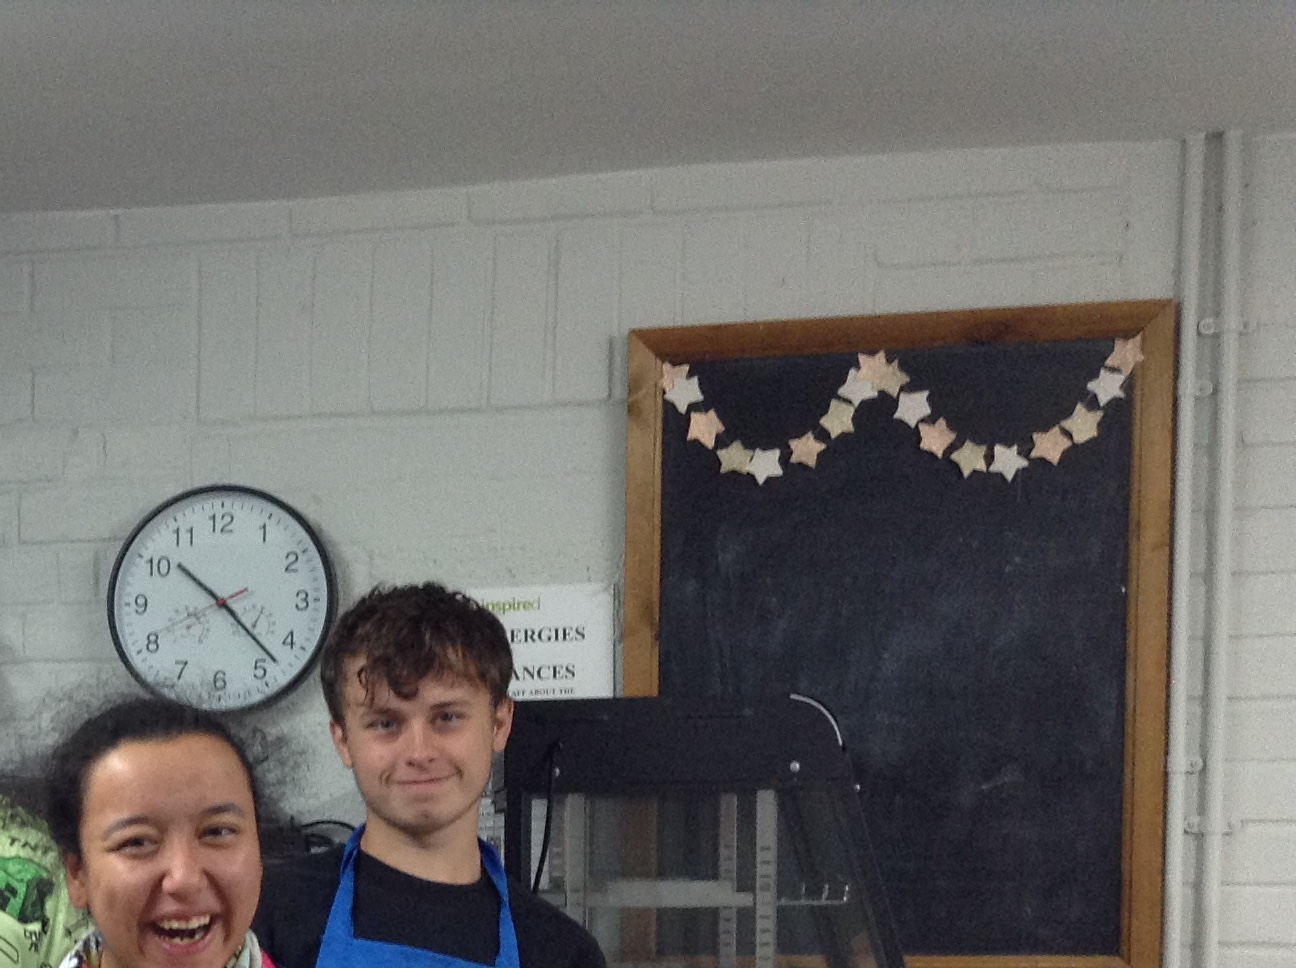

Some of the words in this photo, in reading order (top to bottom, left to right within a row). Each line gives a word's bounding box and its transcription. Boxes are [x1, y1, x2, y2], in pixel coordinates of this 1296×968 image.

[208, 512, 234, 534] 12
[259, 523, 266, 543] 1
[173, 527, 193, 547] 11
[146, 556, 171, 577] 10
[284, 551, 299, 573] 2
[134, 594, 148, 615] 9
[295, 589, 309, 611] 3
[146, 632, 159, 653] 8
[282, 630, 296, 650] 4
[511, 625, 586, 644] ERGIES
[175, 660, 188, 680] 7
[254, 658, 267, 680] 5
[213, 670, 227, 690] 6
